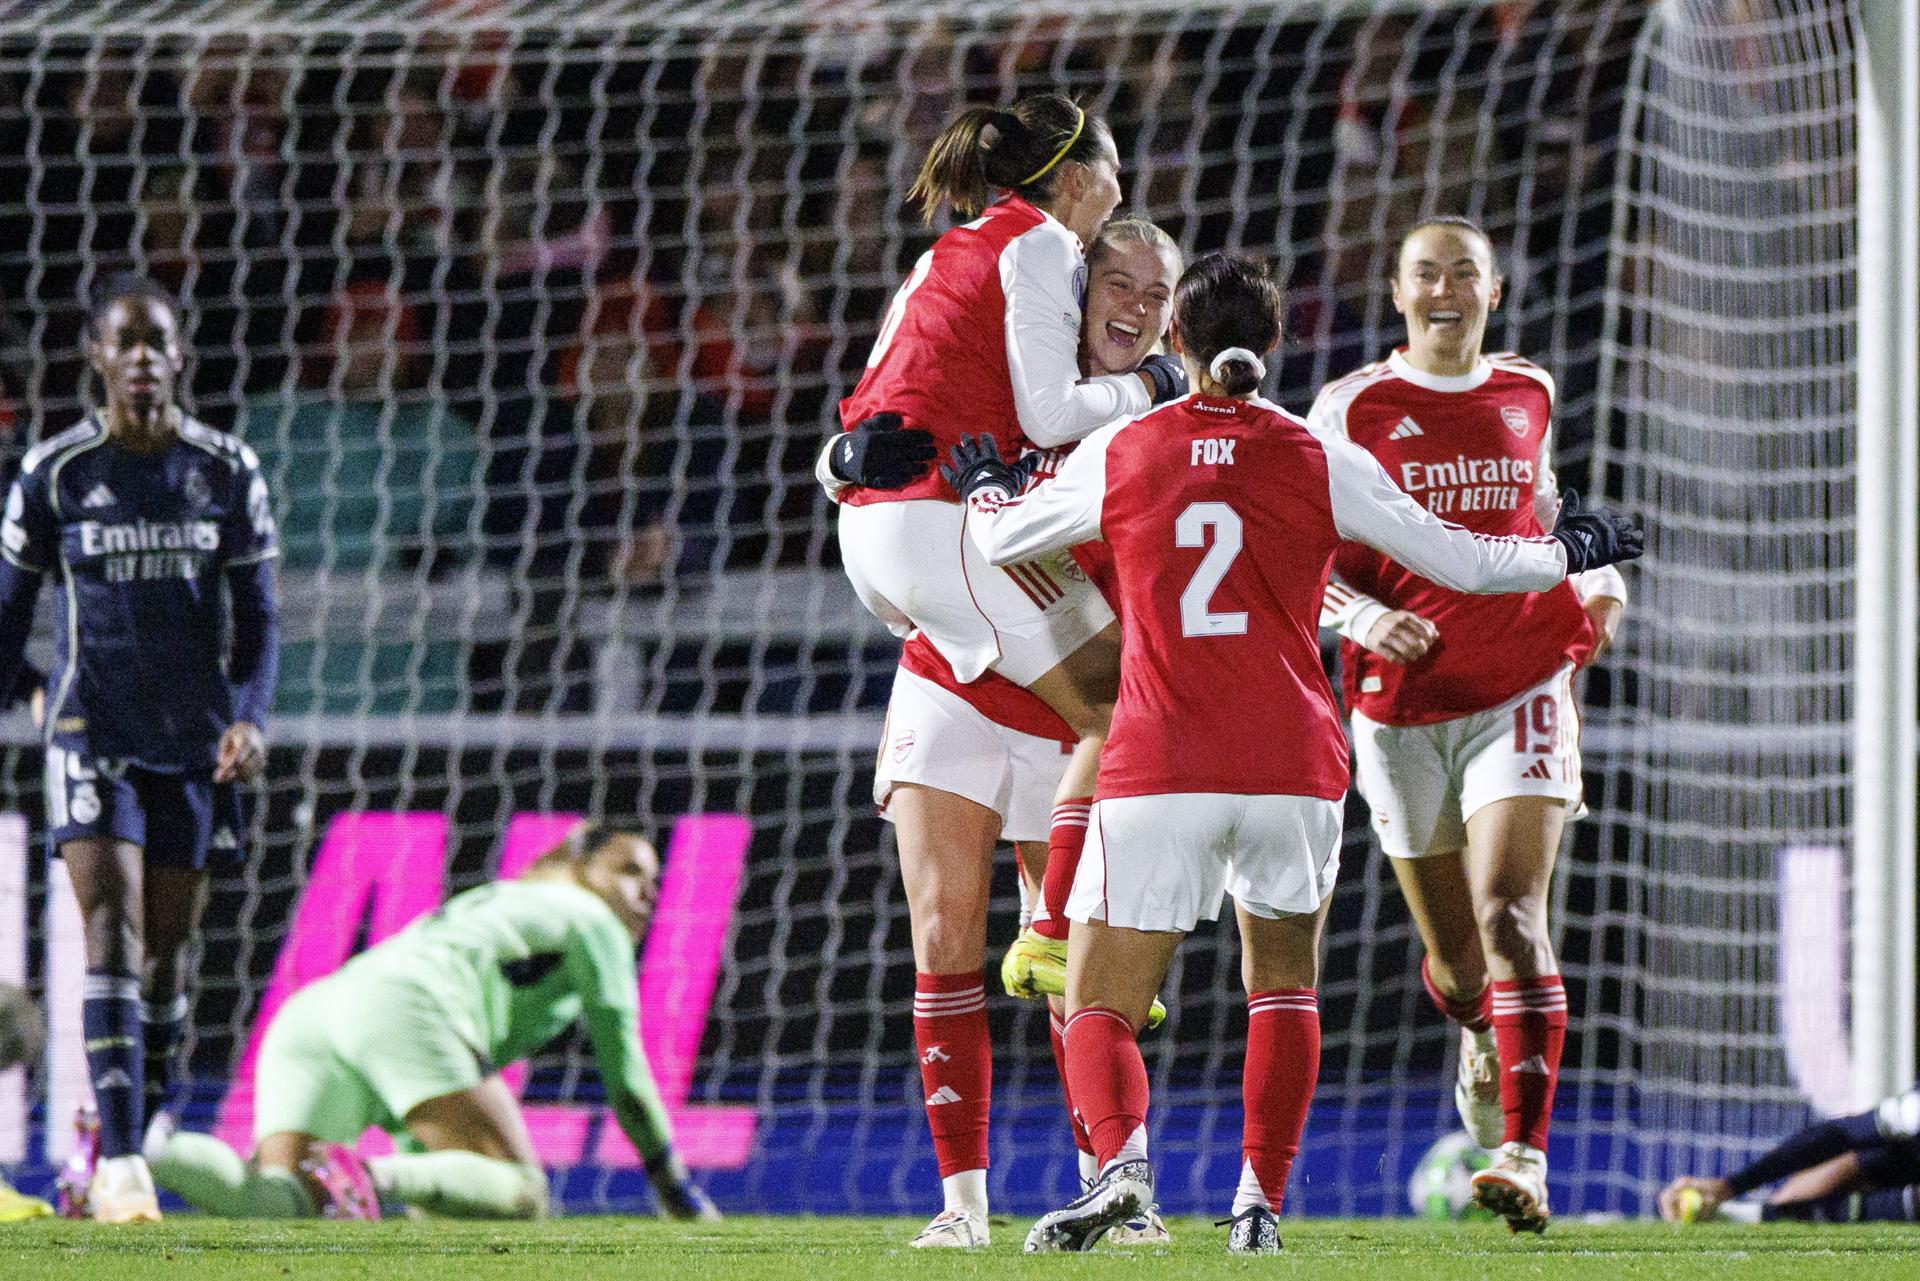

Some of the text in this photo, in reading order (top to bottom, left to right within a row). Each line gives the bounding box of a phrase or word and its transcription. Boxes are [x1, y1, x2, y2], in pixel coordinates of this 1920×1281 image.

[1193, 401, 1236, 414] Arsenal
[1190, 438, 1236, 466] FOX
[1400, 454, 1534, 492] Emirates
[1428, 487, 1519, 514] FLY BETTER
[1175, 501, 1248, 637] 2
[1513, 694, 1557, 754] 19
